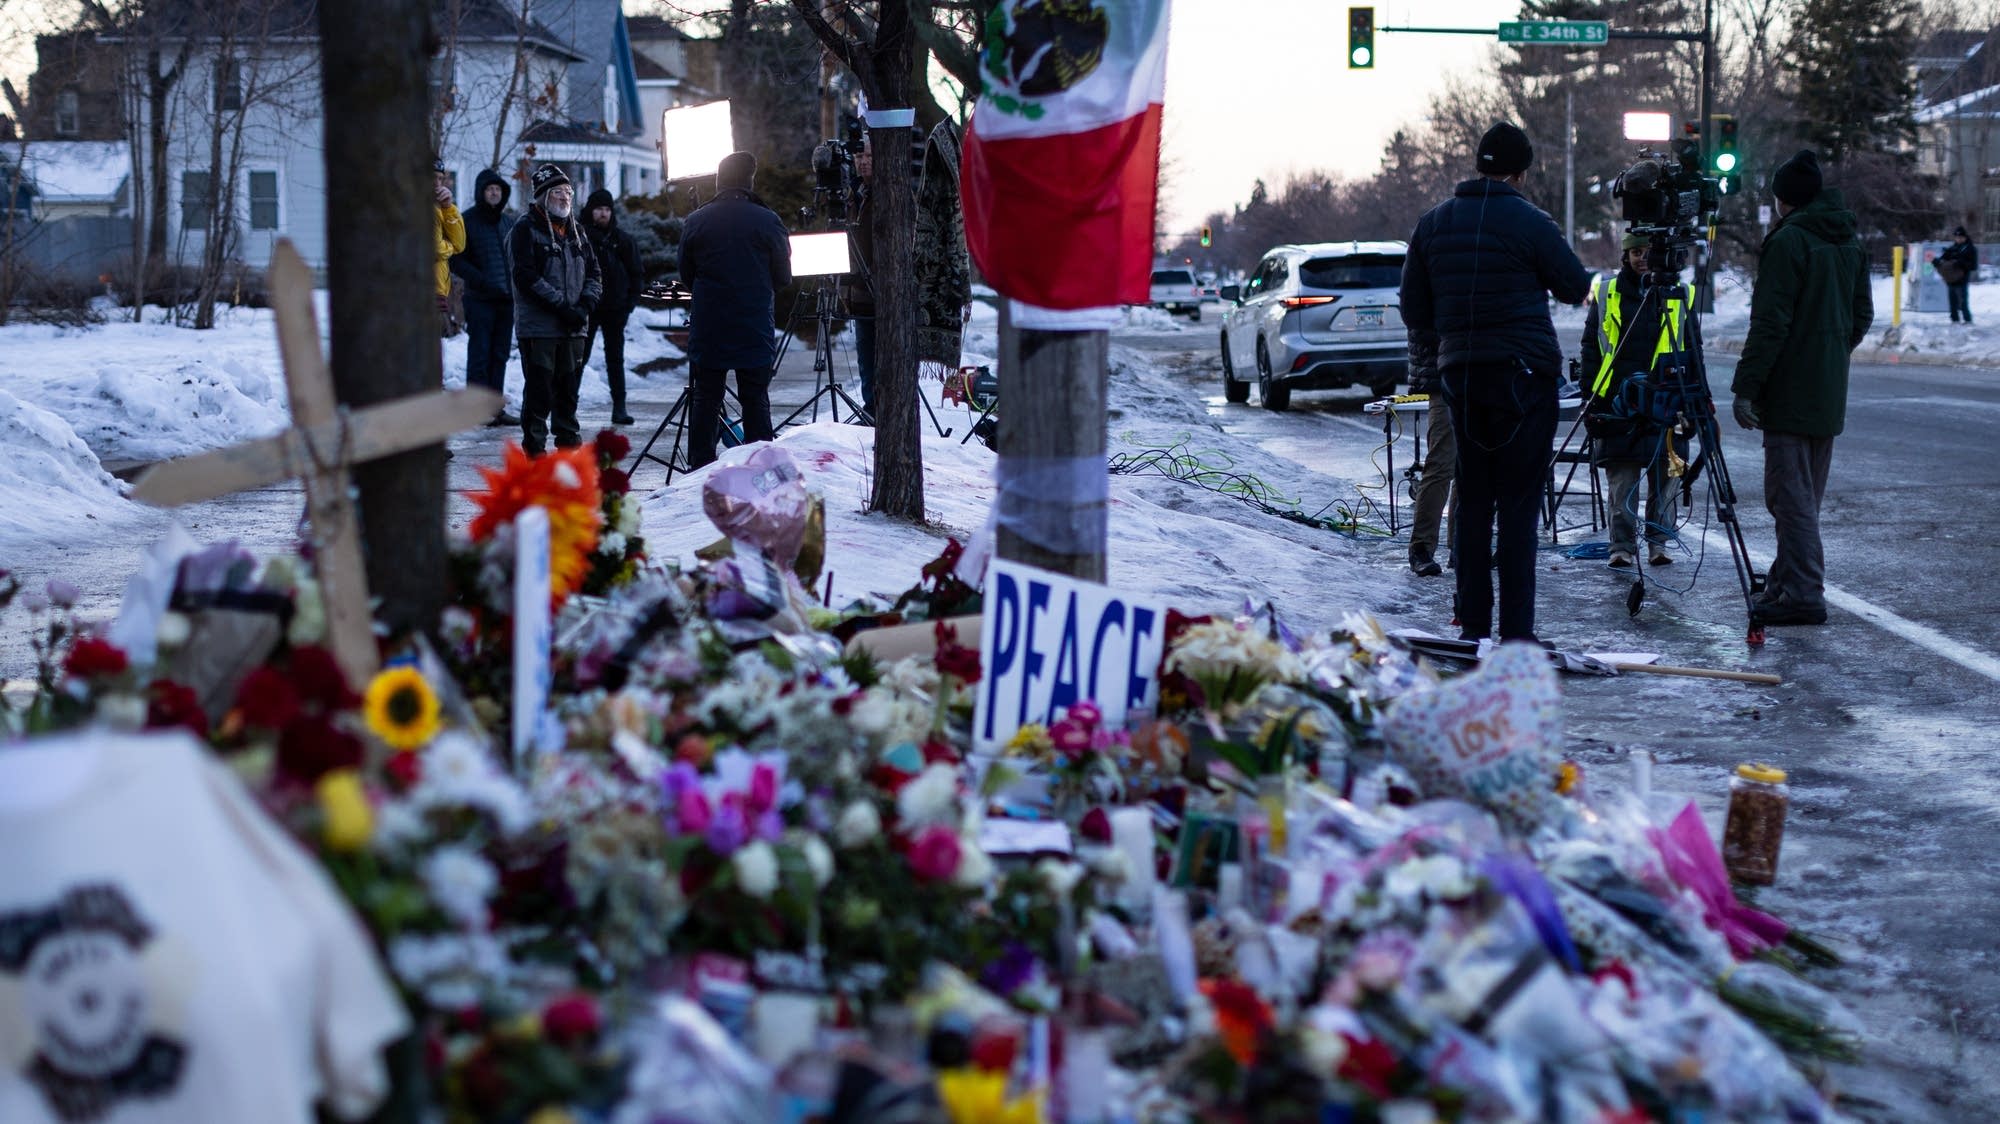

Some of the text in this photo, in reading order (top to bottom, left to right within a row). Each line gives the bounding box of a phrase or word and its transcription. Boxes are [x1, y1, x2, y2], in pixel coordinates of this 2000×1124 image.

[1522, 25, 1603, 39] E 34th St
[984, 572, 1156, 741] PEACE
